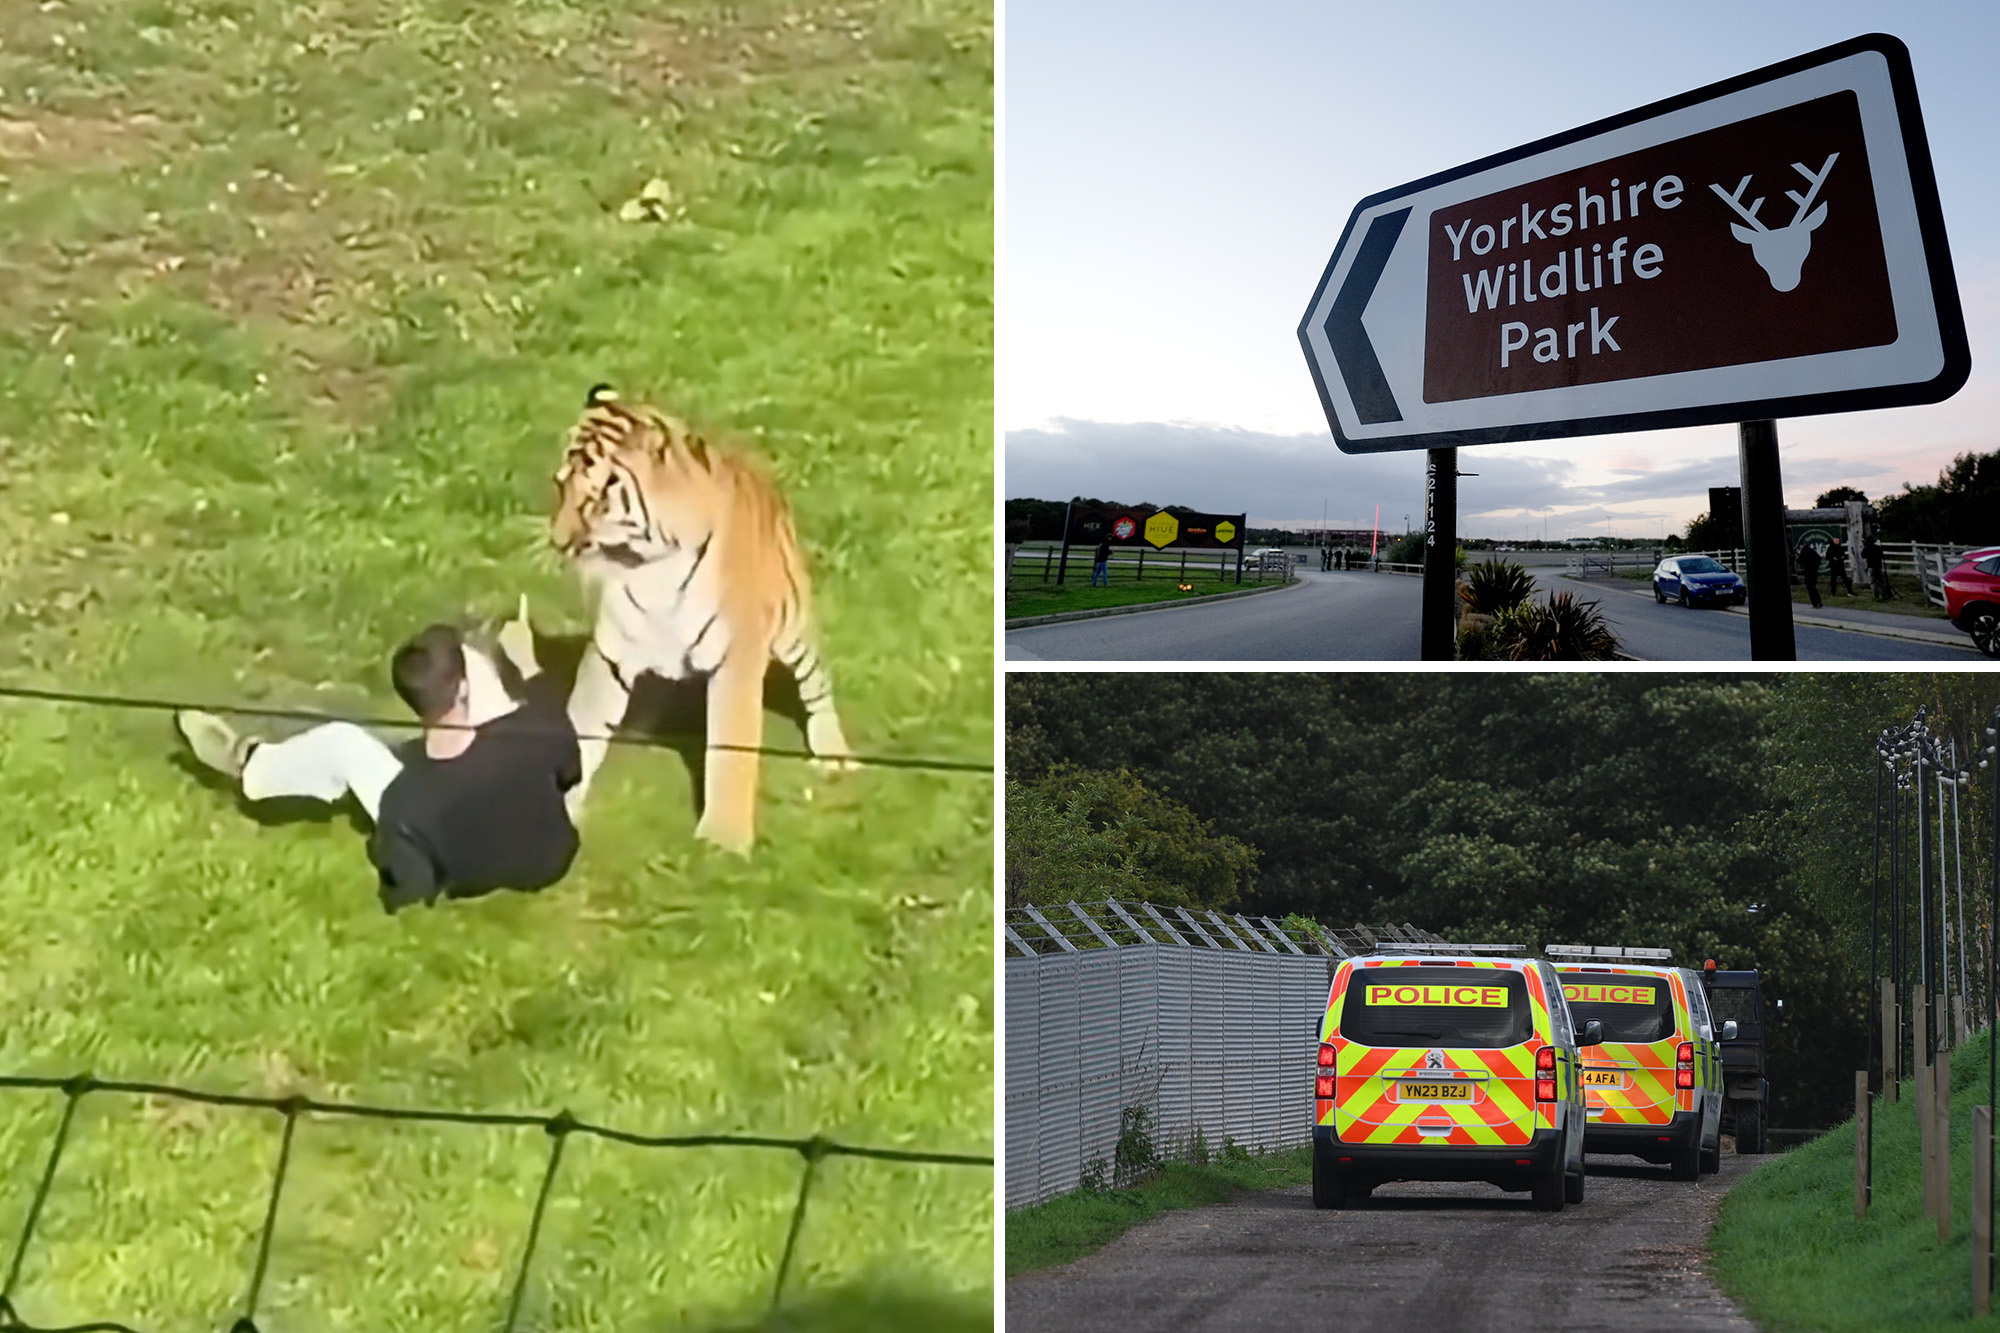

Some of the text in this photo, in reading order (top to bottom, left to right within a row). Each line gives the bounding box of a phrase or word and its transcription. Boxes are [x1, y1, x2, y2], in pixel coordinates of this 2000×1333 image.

[1443, 174, 1685, 262] Yorkshire
[1462, 236, 1665, 314] Wildlife
[1501, 306, 1623, 368] Park
[1371, 987, 1502, 1006] POLICE
[1562, 986, 1650, 1003] OLICE
[1595, 1074, 1616, 1084] AFA
[1406, 1085, 1467, 1098] YN23 BZJ
